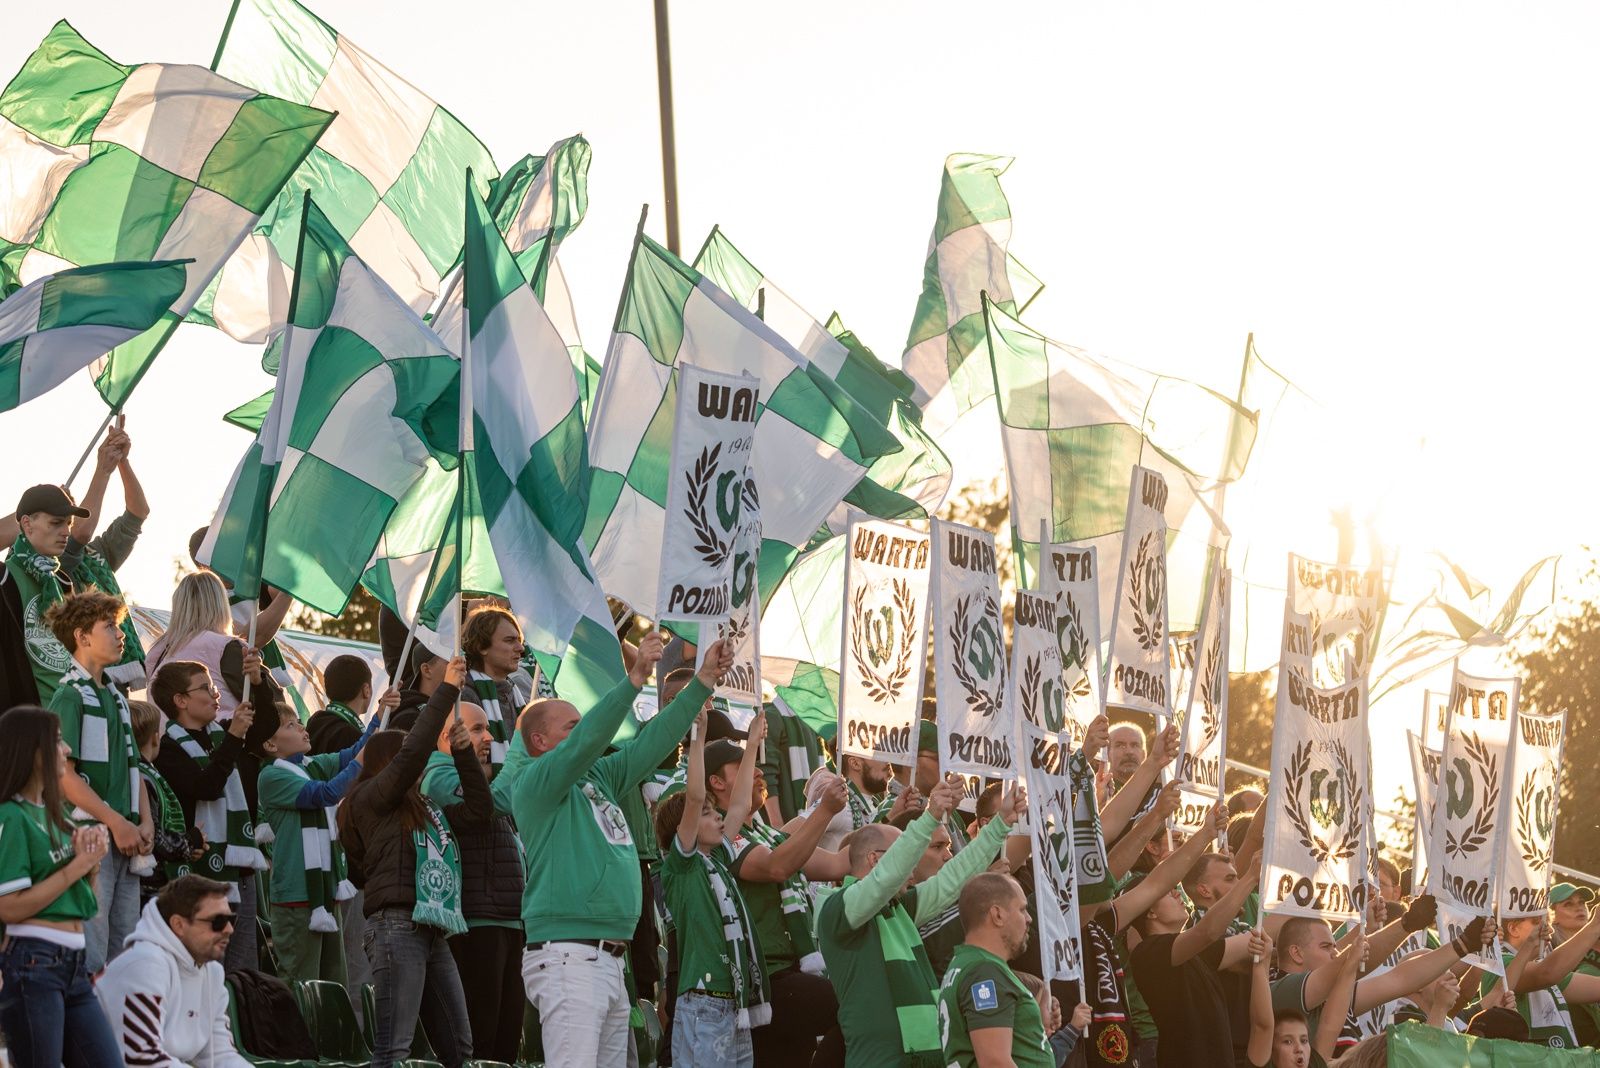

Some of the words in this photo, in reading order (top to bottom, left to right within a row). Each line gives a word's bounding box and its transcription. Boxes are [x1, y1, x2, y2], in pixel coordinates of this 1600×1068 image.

[854, 527, 930, 570] WARTA
[1454, 682, 1508, 720] RTA
[848, 719, 911, 753] POZNAŃ
[950, 732, 1011, 769] POZNAŃ
[1277, 873, 1367, 913] POZNAŃ
